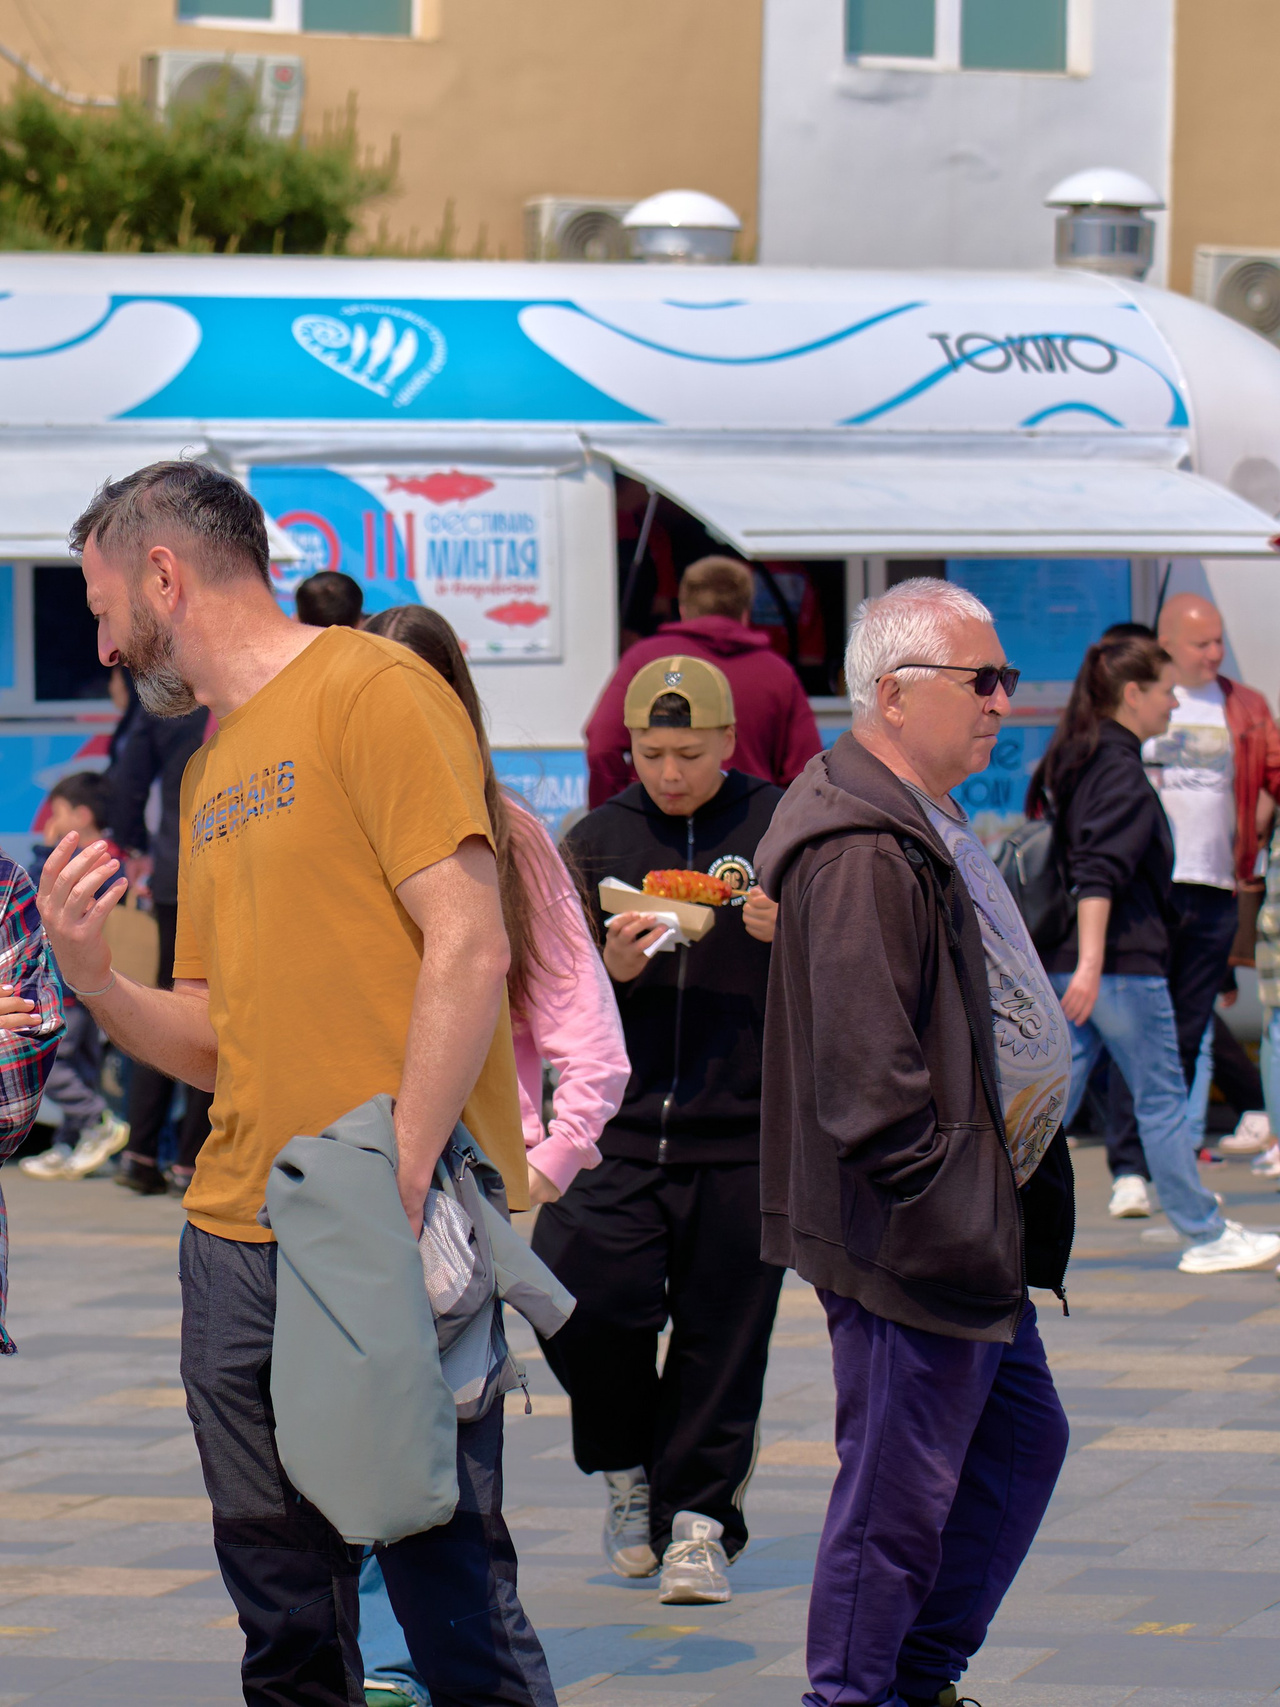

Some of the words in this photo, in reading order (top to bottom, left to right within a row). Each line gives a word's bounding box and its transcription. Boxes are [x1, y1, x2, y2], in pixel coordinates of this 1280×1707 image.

[927, 331, 1119, 375] ТОКИО
[425, 537, 539, 580] МИНТАЯ
[191, 762, 296, 851] IMBERLAND
